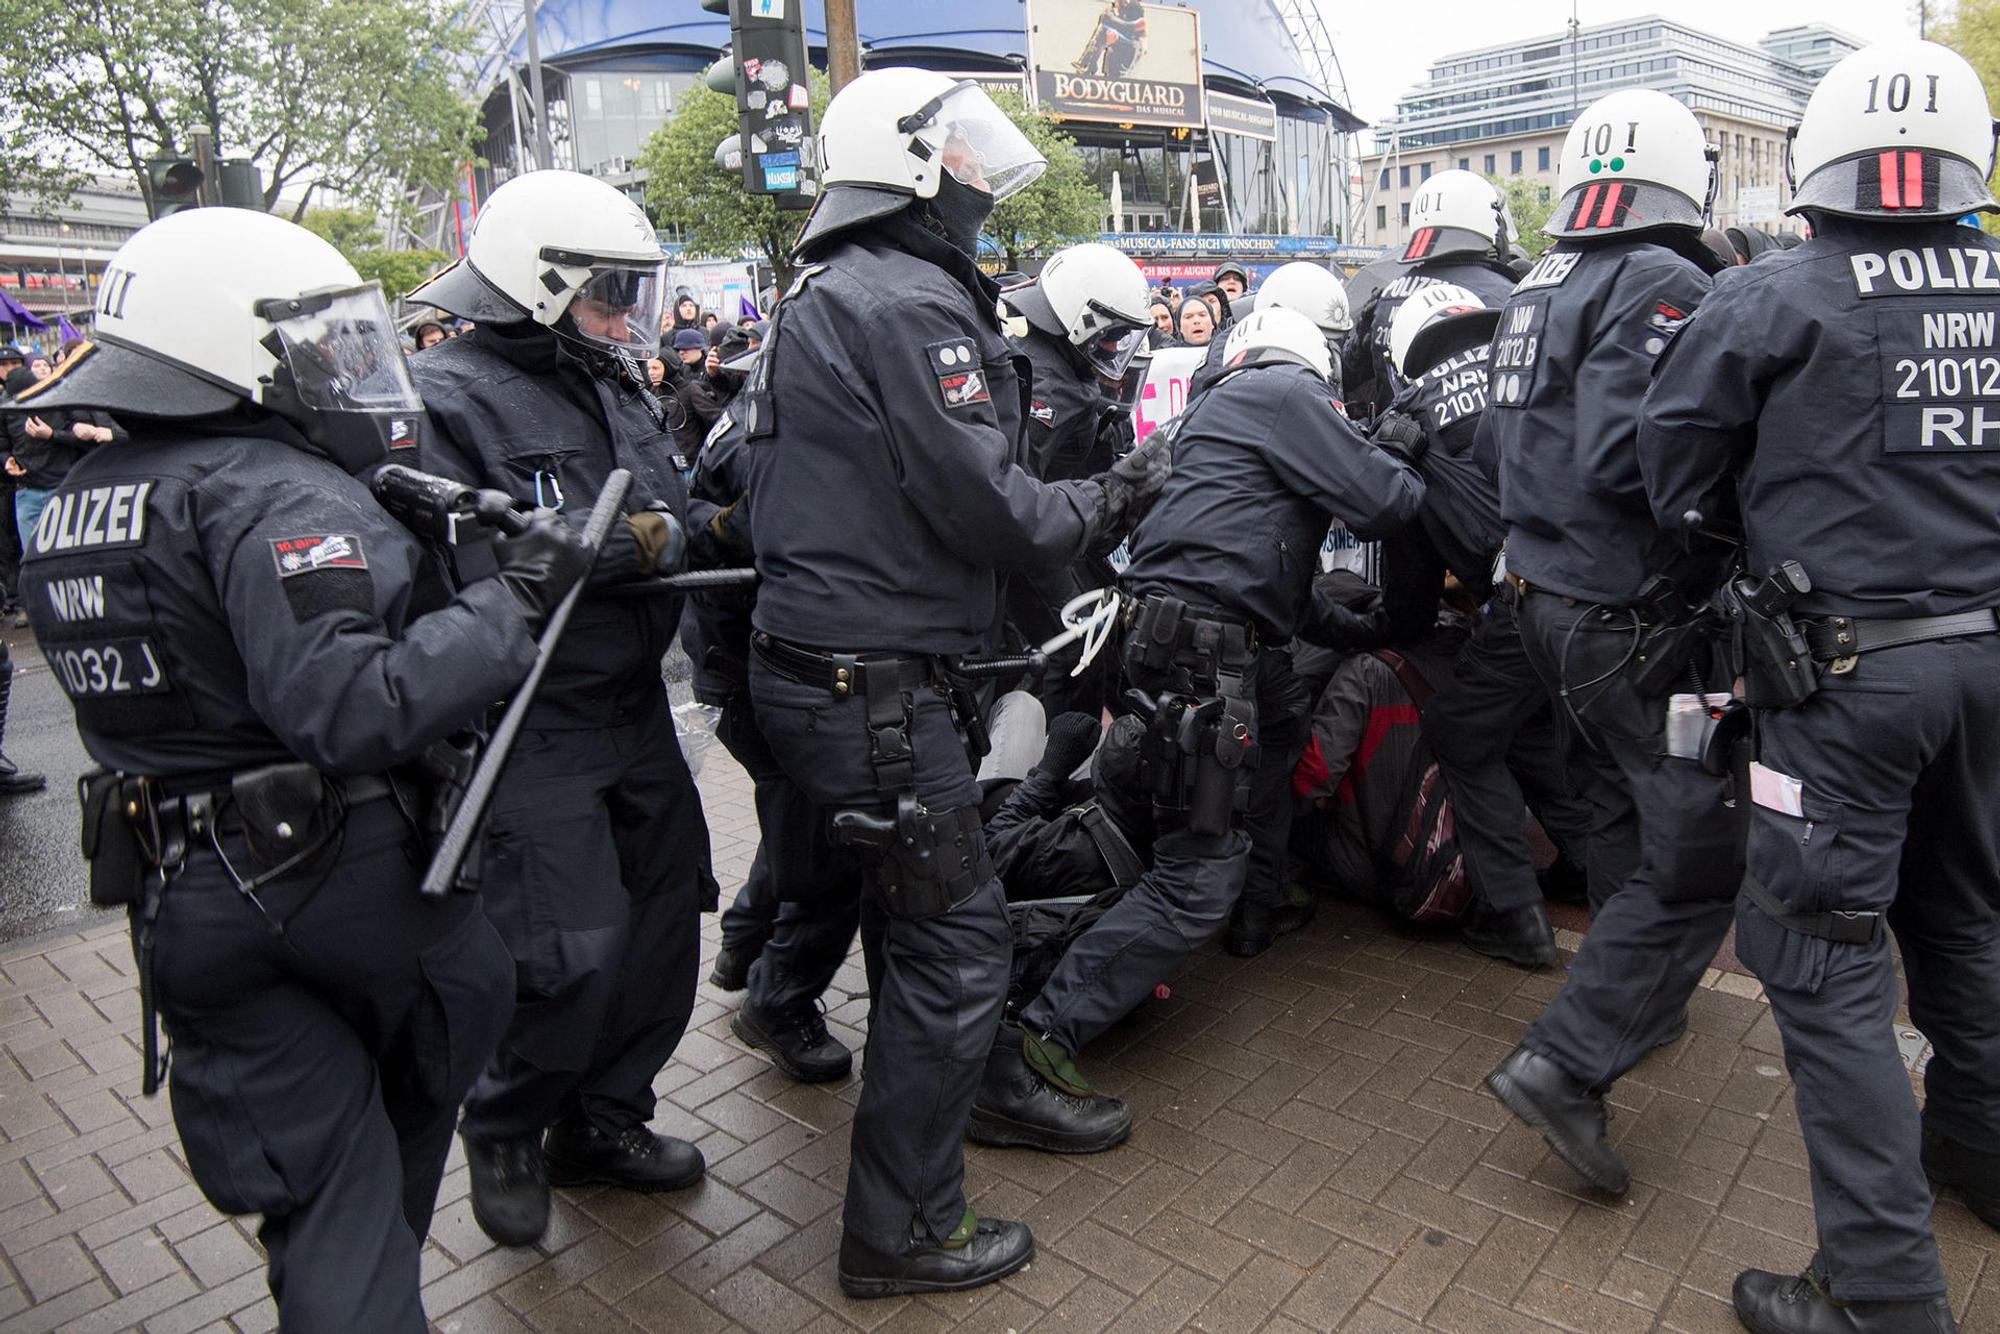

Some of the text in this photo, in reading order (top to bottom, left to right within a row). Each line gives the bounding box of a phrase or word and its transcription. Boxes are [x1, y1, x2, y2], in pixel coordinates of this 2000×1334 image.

[1054, 74, 1185, 106] BODYGUARD
[1864, 73, 1911, 113] 10
[1136, 105, 1185, 116] DAS MUSICAL
[1580, 123, 1613, 158] 10
[1120, 237, 1197, 250] MUSICAL-FANS
[1198, 238, 1220, 250] SICH
[1157, 266, 1171, 277] BIS
[1183, 265, 1217, 276] AUGUST
[1923, 312, 1996, 349] NRW
[1525, 337, 1537, 366] B
[1435, 385, 1488, 427] 2101
[31, 483, 150, 554] OLIZEI
[48, 575, 104, 622] NRW
[48, 643, 161, 694] 1032 J
